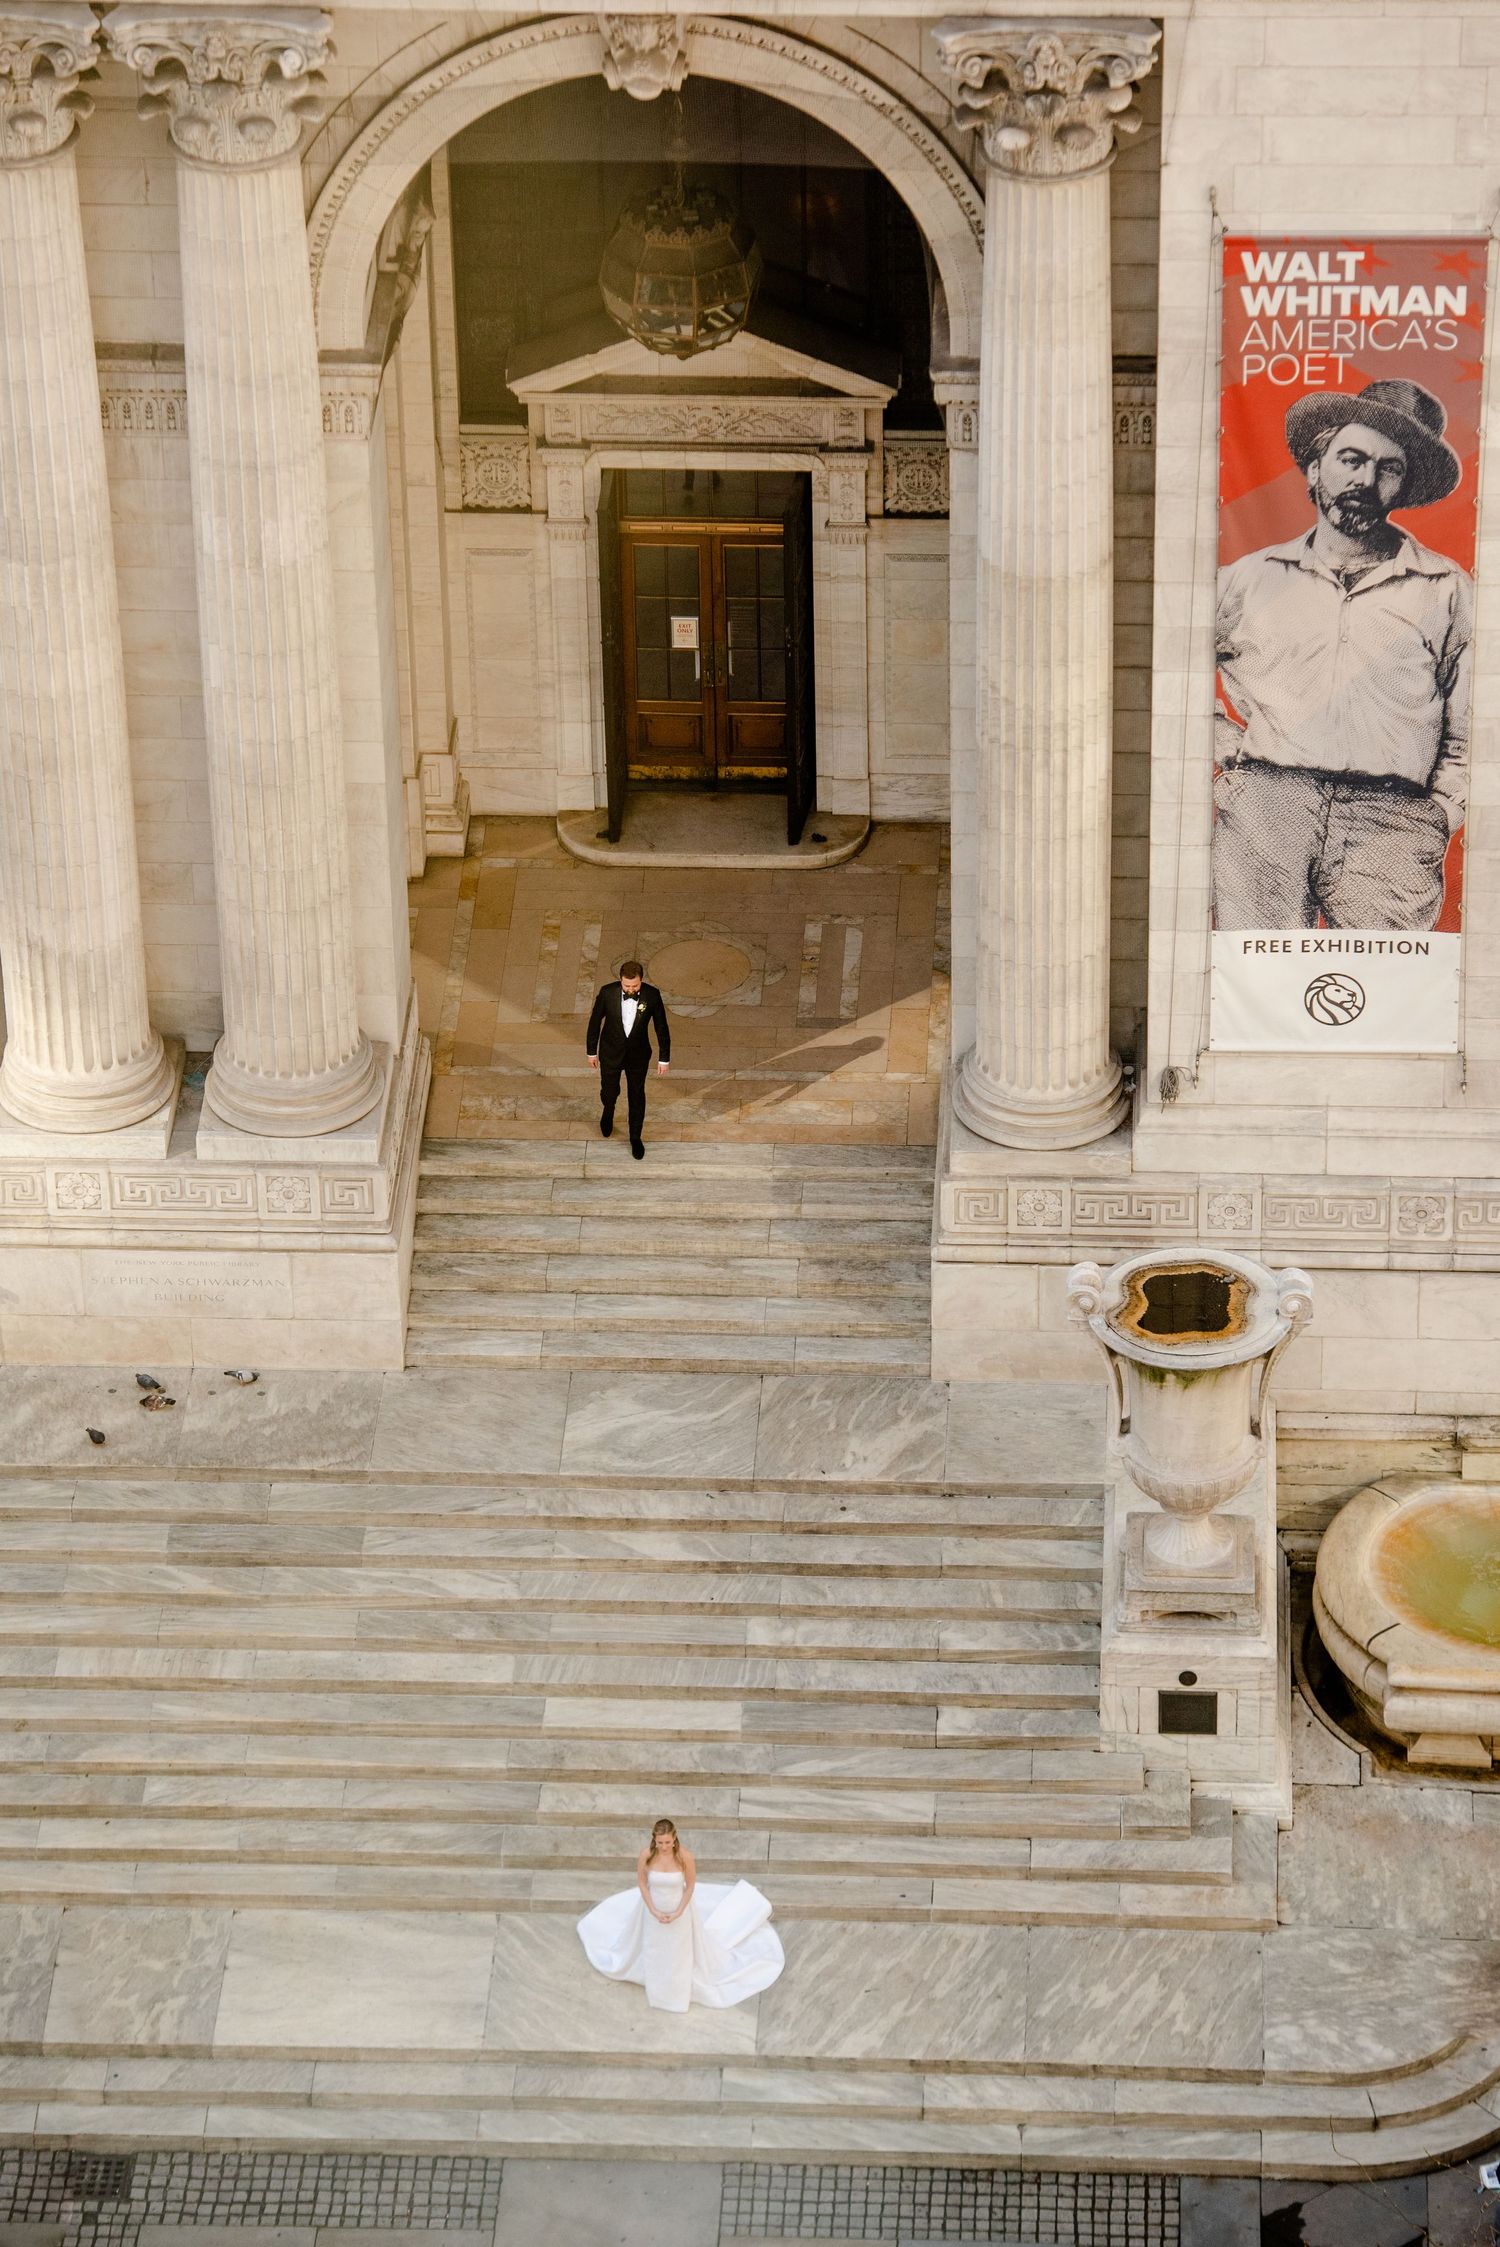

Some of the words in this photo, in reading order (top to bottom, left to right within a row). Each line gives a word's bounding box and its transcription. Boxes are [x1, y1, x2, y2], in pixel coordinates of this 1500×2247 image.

[1240, 251, 1366, 283] WALT
[1239, 285, 1468, 317] WHITMAN
[1239, 318, 1459, 353] AMERICA'S
[1242, 352, 1355, 387] POET
[1242, 939, 1292, 955] FREE
[1300, 938, 1431, 956] EXHIBITION
[154, 1293, 225, 1303] BUILDING
[164, 1277, 174, 1286] A
[177, 1277, 287, 1288] SCHWARZMAN
